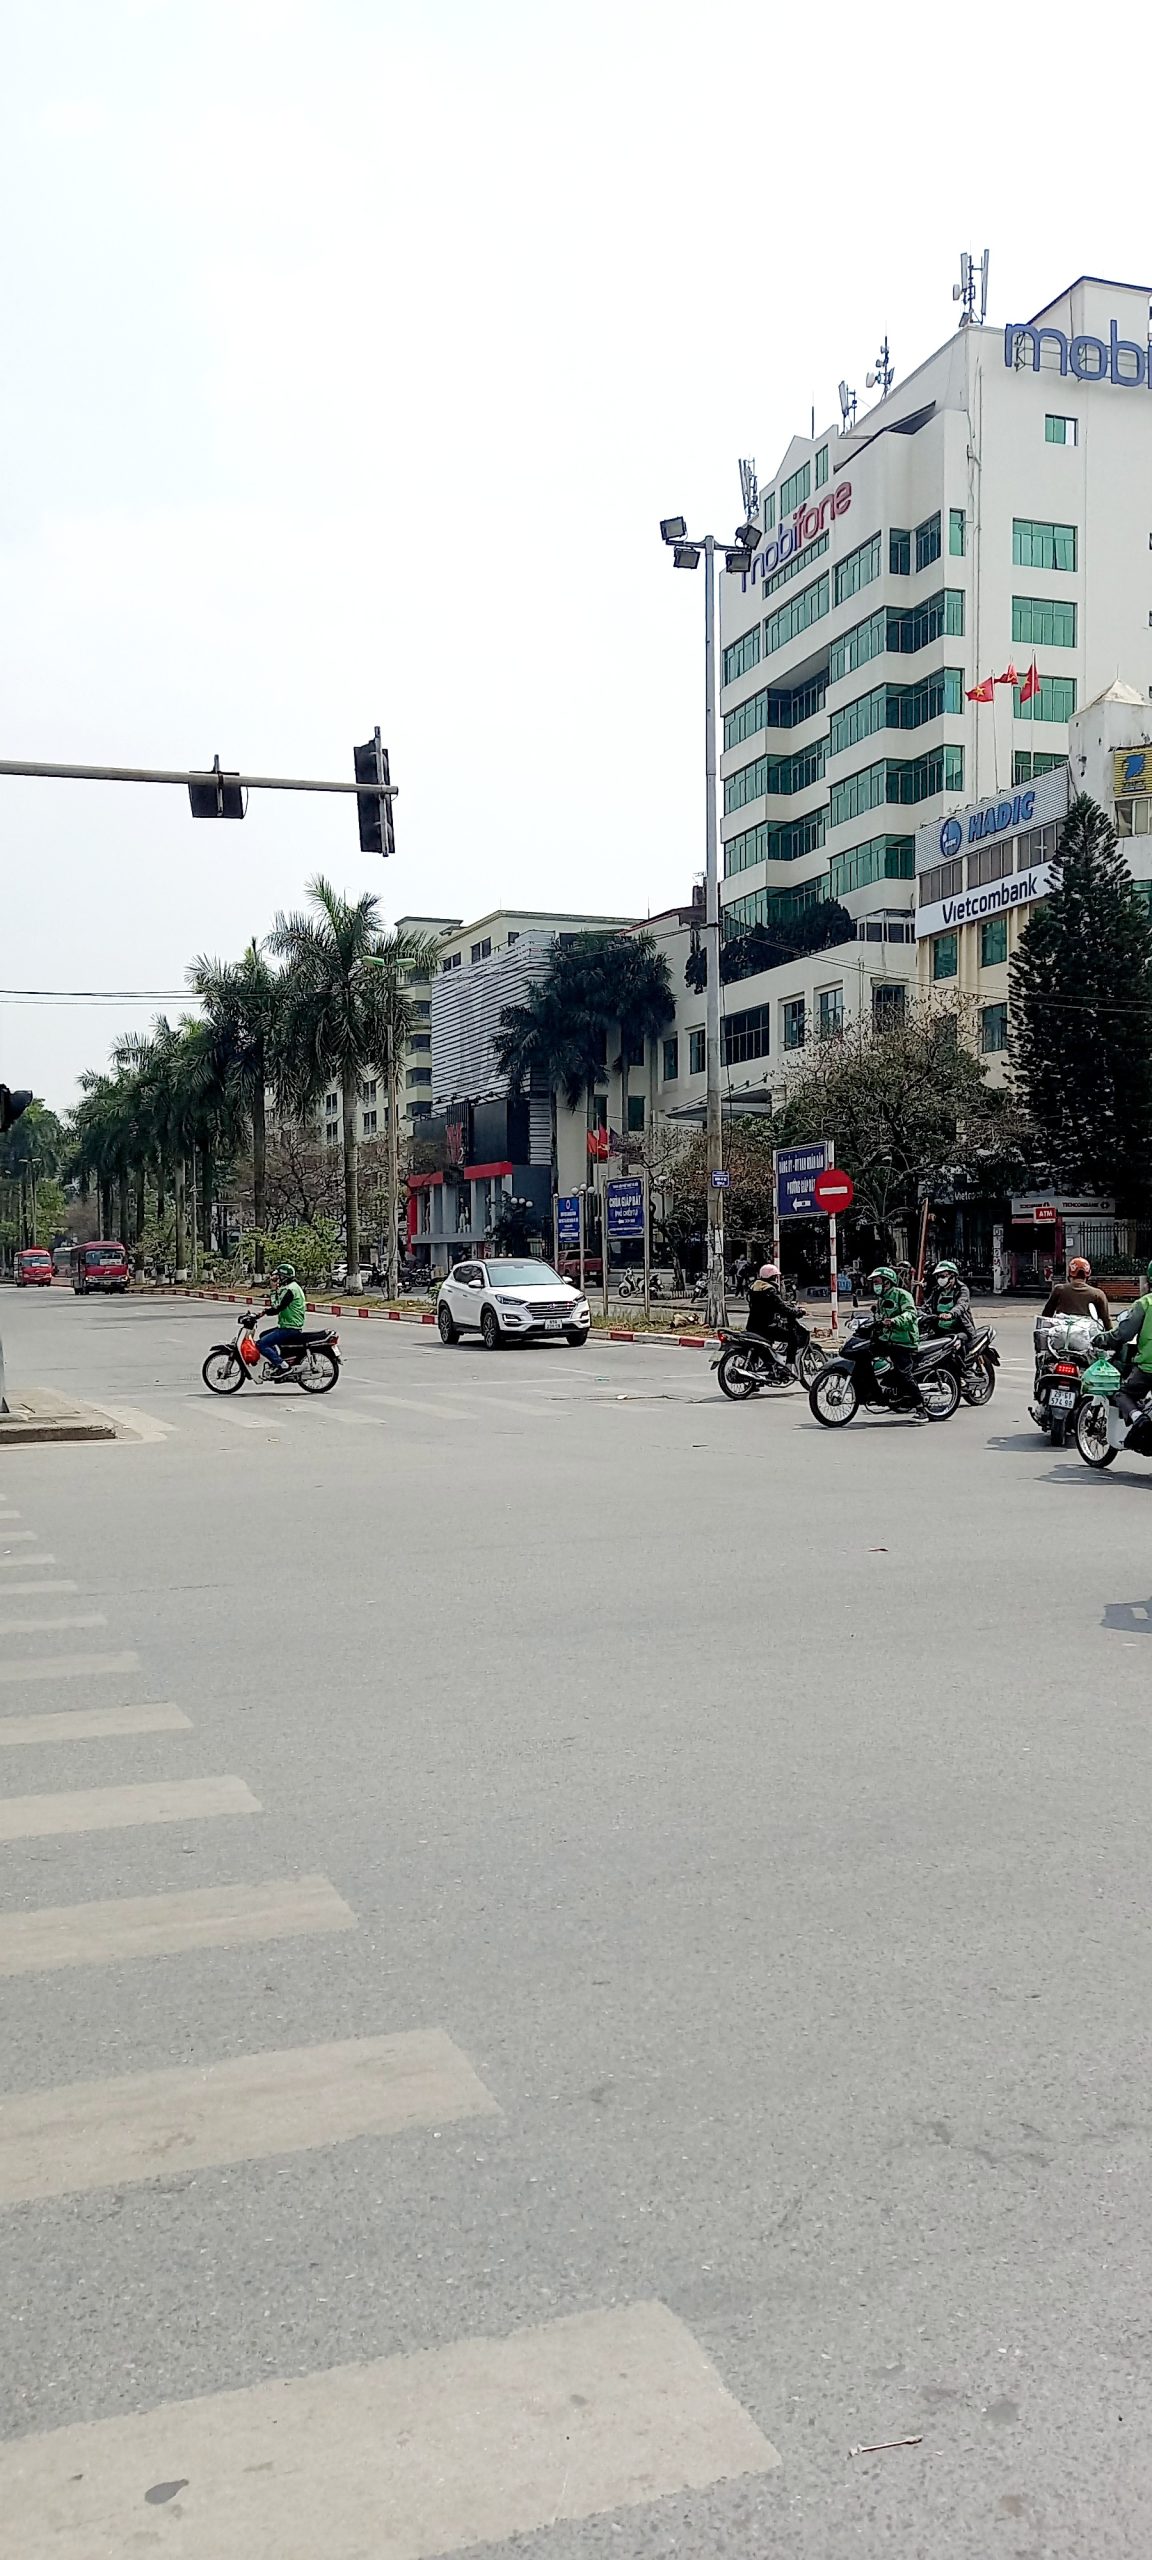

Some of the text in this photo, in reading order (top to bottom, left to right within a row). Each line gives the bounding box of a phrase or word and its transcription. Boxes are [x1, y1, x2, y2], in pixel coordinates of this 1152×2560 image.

[742, 481, 852, 593] mobifone
[968, 790, 1036, 843] HADIC
[943, 872, 1038, 924] Vietcombank
[1038, 1209, 1053, 1218] ATM
